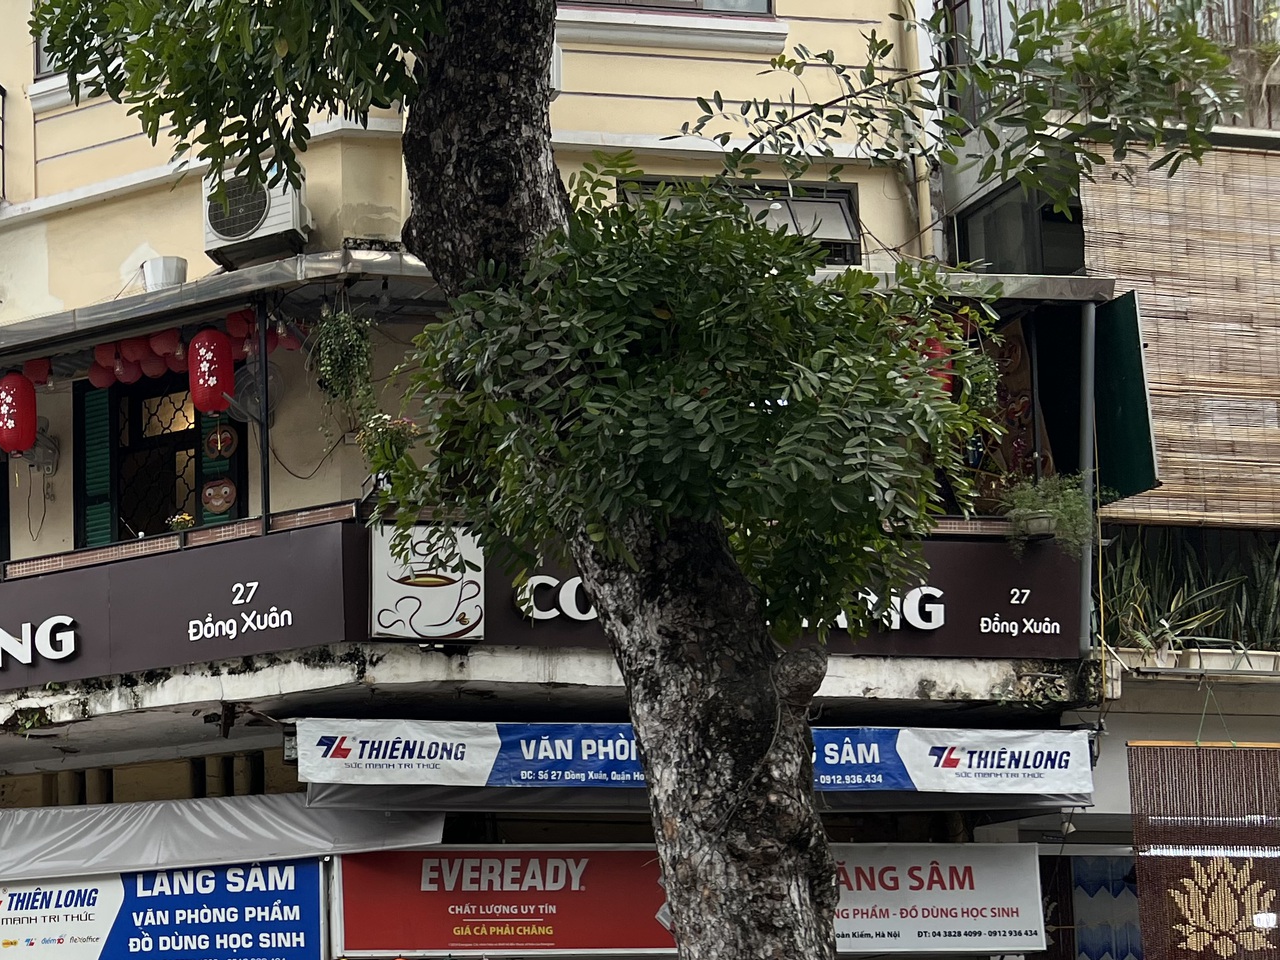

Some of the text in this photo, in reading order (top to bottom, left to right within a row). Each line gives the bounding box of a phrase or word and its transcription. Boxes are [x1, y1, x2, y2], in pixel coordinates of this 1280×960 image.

[231, 581, 259, 606] 27
[1010, 588, 1031, 604] 27
[188, 605, 293, 641] Đồng Xuân
[979, 613, 1061, 636] Đồng Xuân
[520, 735, 573, 760] VĂN
[824, 737, 880, 764] SÂM
[538, 769, 549, 780] Số
[550, 771, 562, 780] 27
[564, 770, 586, 782] Đồng
[610, 771, 630, 783] Quận
[820, 774, 883, 784] 0912.936.434
[420, 858, 589, 892] EVEREADY
[836, 860, 975, 891] ĂNG SÂM
[7, 887, 99, 911] THIÊN LONG
[448, 902, 557, 916] CHẤT LƯỢNG UY TÍN
[41, 914, 60, 923] TRI
[132, 899, 300, 927] VĂN PHÒNG PHẨM
[853, 904, 890, 919] PHẨM
[921, 905, 958, 918] DÙNG
[961, 907, 987, 921] HỌC
[990, 907, 1019, 918] SINH
[453, 923, 553, 936] GIÁ CẢ PHẢI CHĂNG
[875, 930, 885, 939] Hà
[887, 930, 901, 940] Nội
[917, 930, 931, 938] ĐT:
[931, 930, 941, 938] 04
[942, 930, 962, 938] 3828
[963, 930, 982, 938] 4099
[128, 931, 305, 953] ĐỒ DÙNG HỌC SINH
